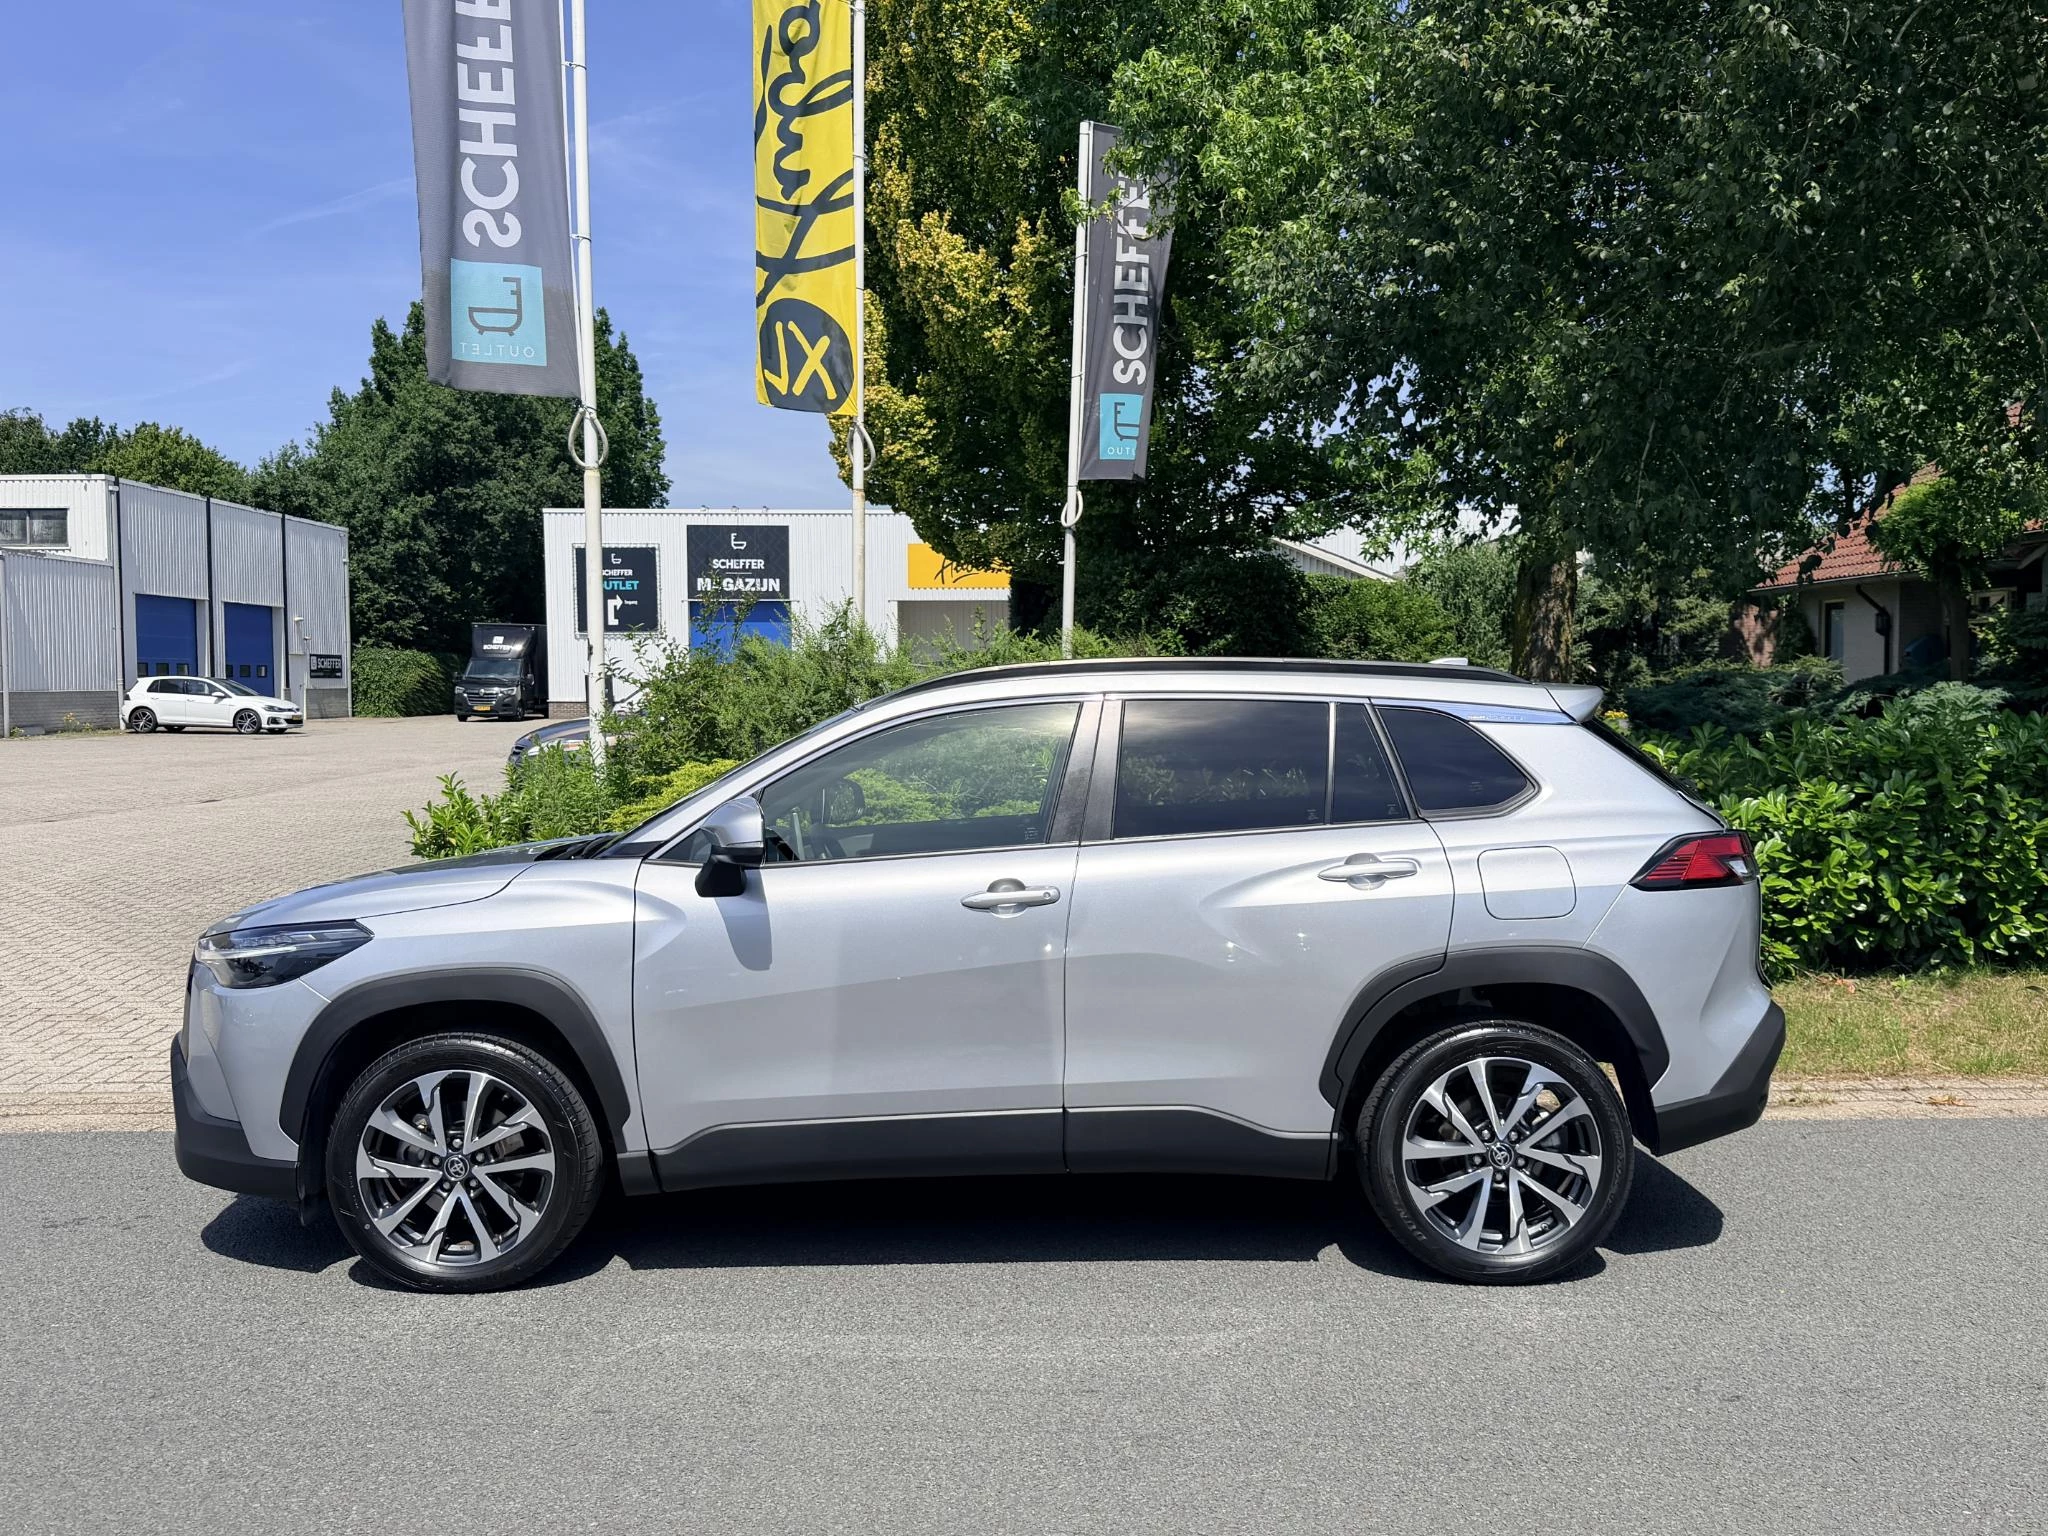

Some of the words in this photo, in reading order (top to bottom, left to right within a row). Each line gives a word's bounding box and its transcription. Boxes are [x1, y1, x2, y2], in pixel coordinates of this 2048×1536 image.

[1112, 170, 1150, 386] SCHEFFE
[712, 558, 765, 570] SCHEFFER
[602, 580, 640, 590] UTLET
[317, 658, 341, 669] SCHEFFER
